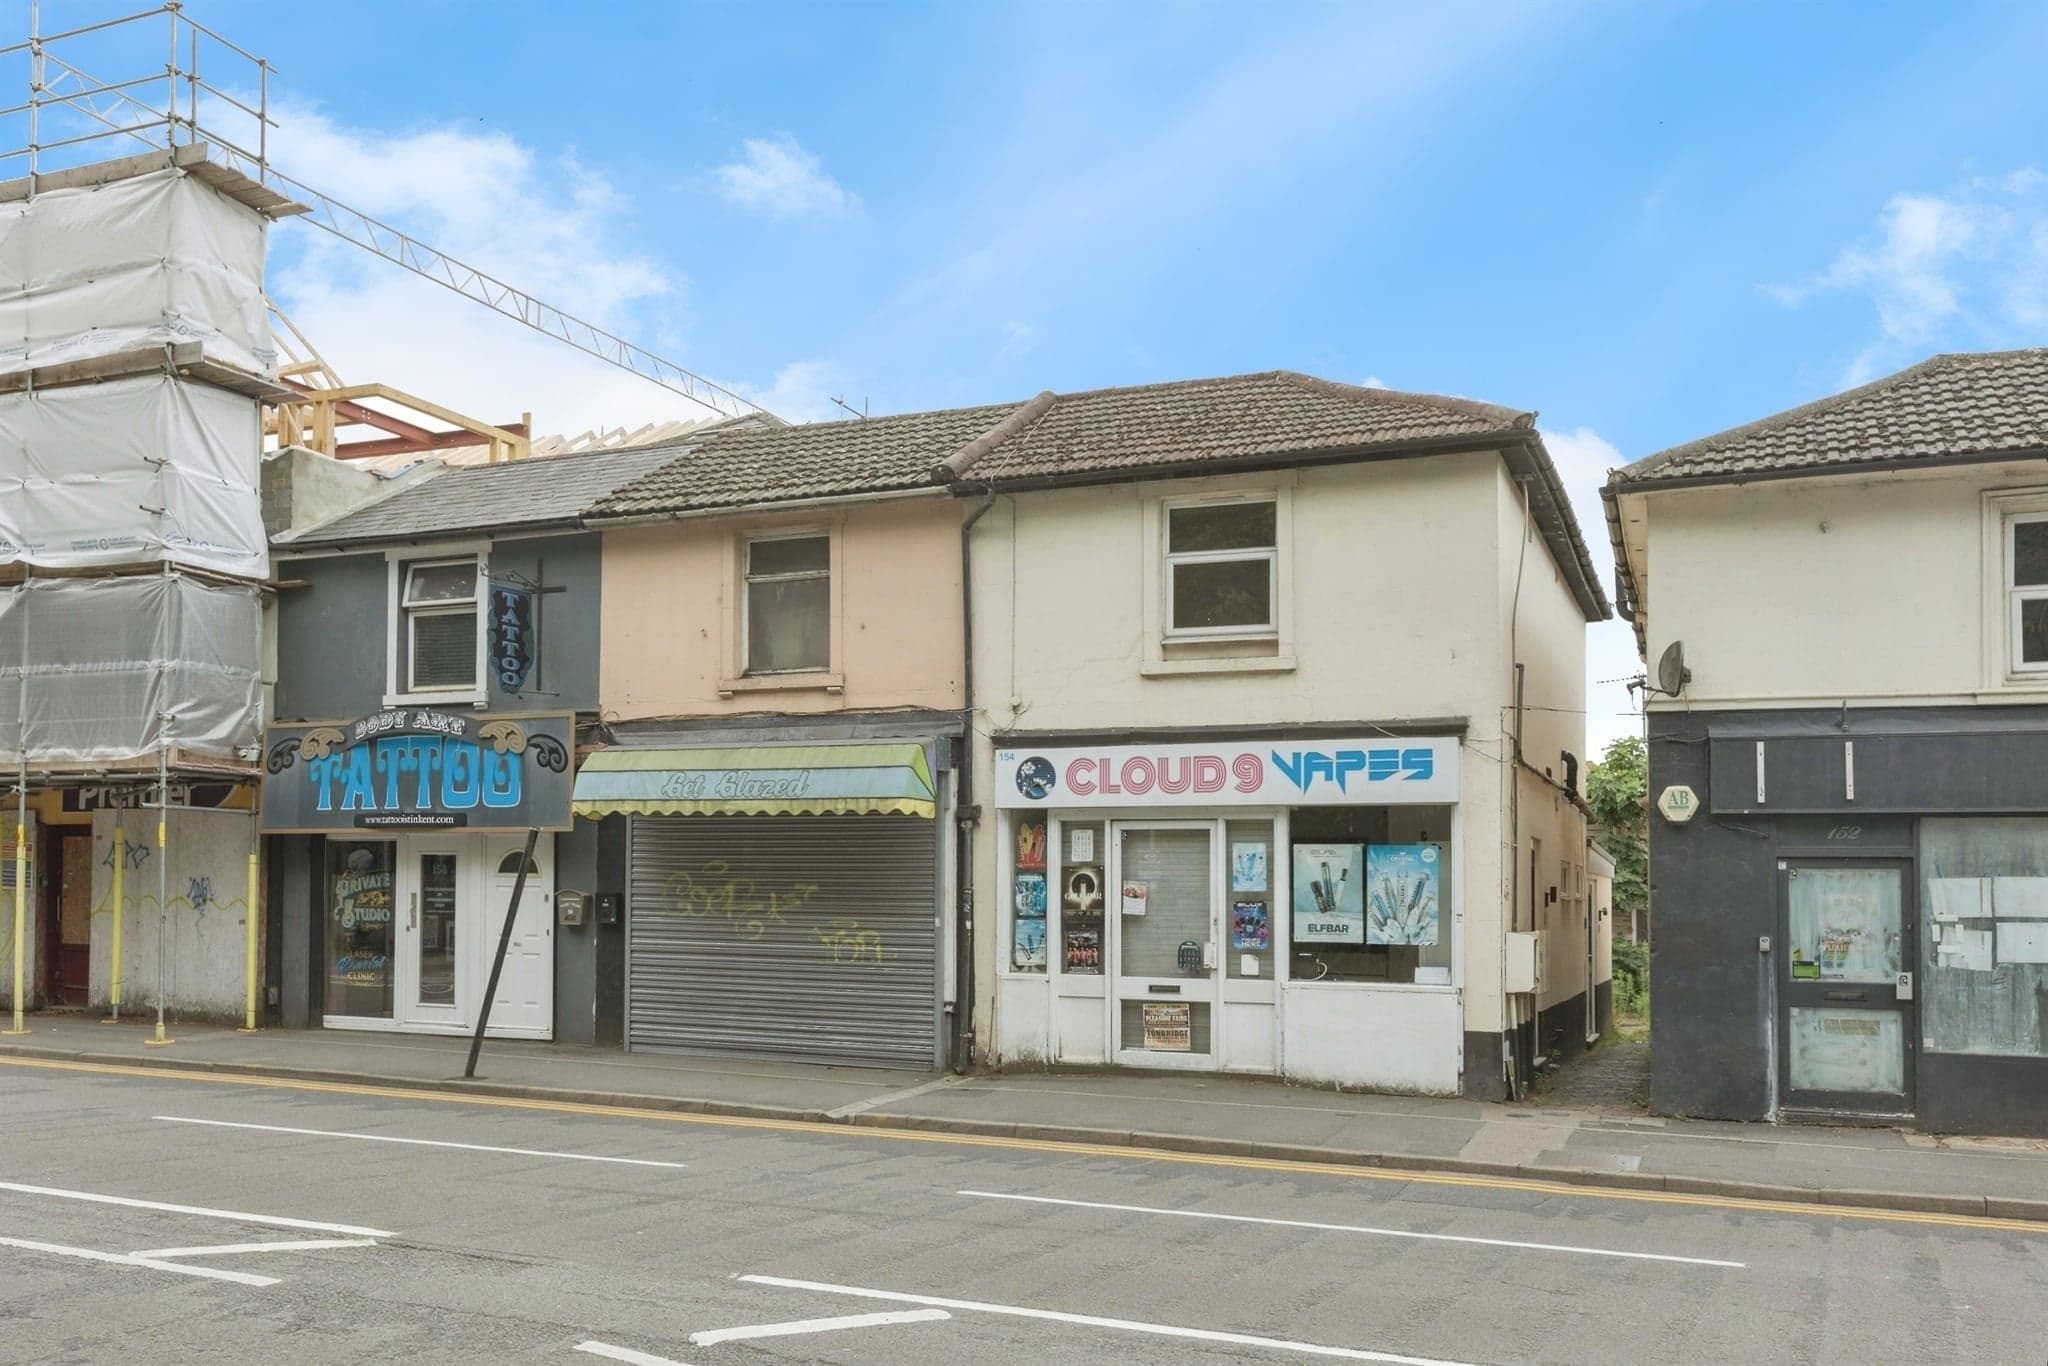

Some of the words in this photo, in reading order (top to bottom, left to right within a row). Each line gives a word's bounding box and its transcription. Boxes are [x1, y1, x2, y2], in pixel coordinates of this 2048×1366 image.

[501, 592, 520, 685] TATTOO
[355, 711, 407, 739] BODY
[412, 710, 466, 736] ART
[1000, 753, 1015, 761] 154
[309, 736, 522, 811] TATTOO
[1272, 749, 1433, 796] VAPES
[661, 771, 706, 798] Get
[714, 770, 810, 798] Glazed
[1668, 791, 1689, 806] AB
[364, 813, 454, 825] www.tattooistinkent.com
[1827, 826, 1862, 840] 152
[1308, 924, 1349, 933] ELFBAR
